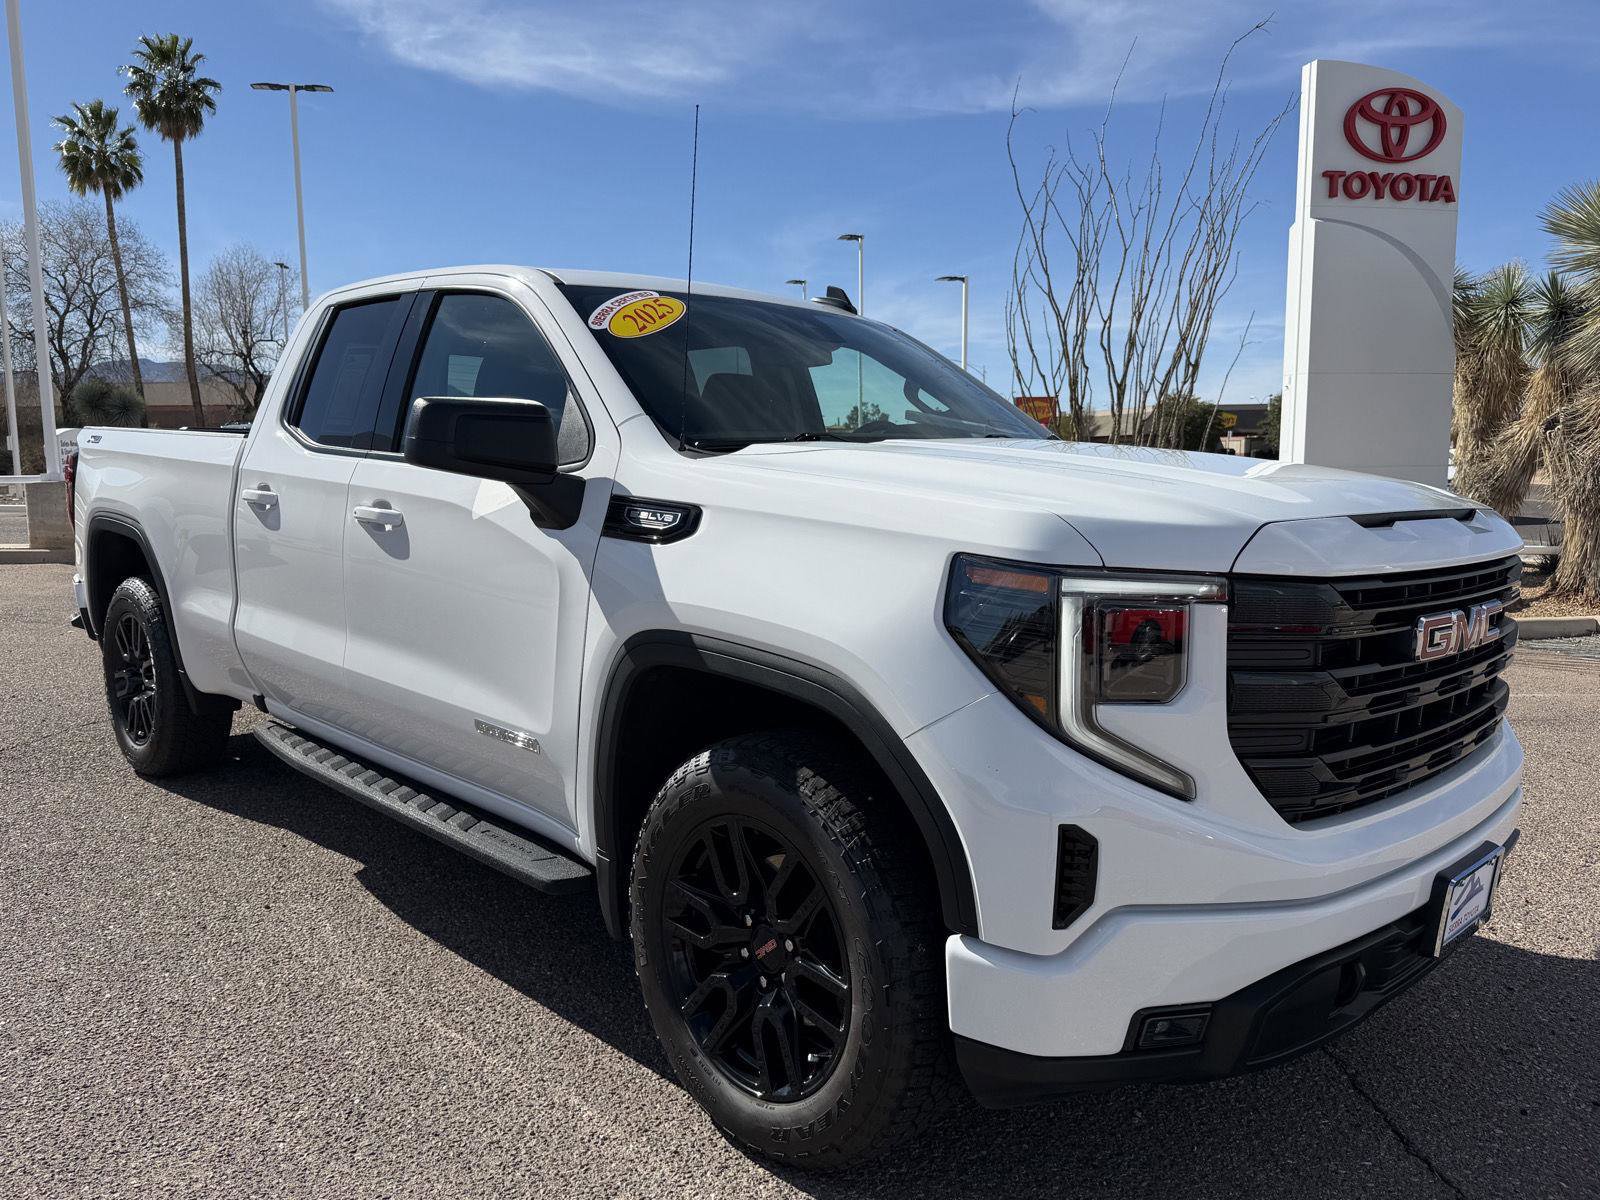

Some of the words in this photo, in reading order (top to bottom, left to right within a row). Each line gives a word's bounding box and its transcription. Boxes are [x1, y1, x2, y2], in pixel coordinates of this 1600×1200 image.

[1322, 170, 1456, 203] TOYOTA
[623, 299, 674, 332] 2025
[1415, 599, 1503, 661] GMC
